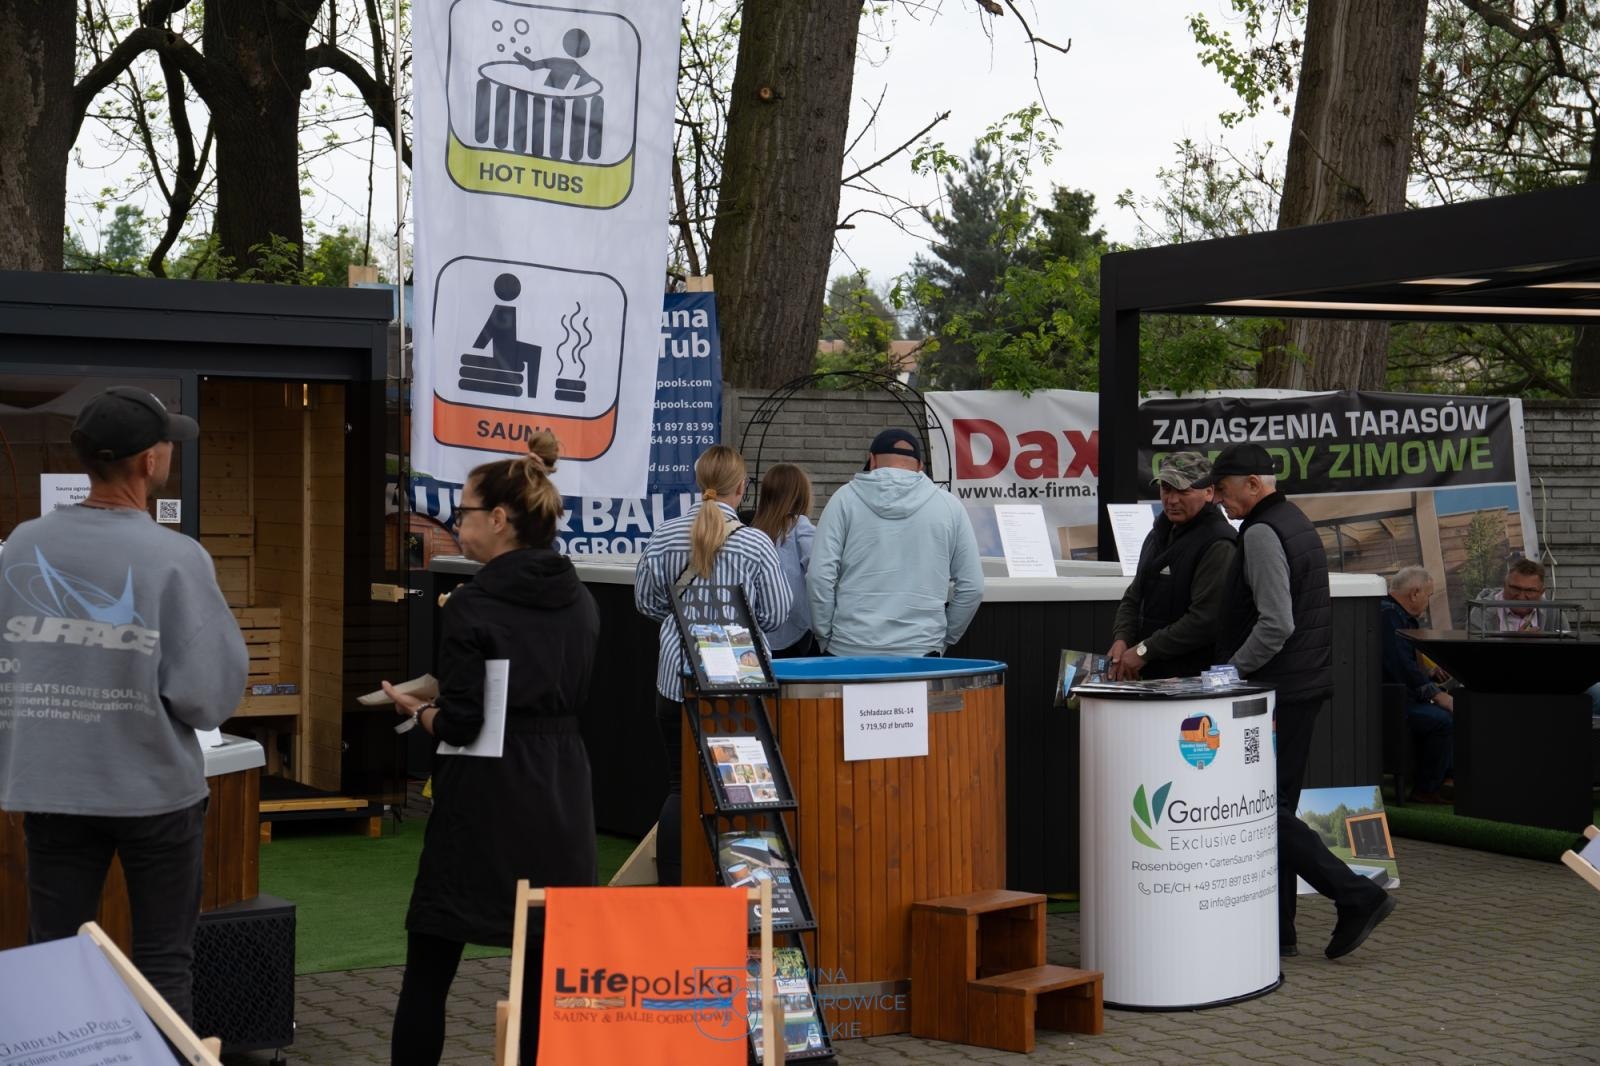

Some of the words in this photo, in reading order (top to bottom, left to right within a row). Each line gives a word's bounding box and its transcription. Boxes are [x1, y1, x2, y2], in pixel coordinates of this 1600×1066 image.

[479, 162, 526, 184] HOT
[531, 168, 584, 194] TUBS
[657, 377, 713, 391] pools.com
[653, 398, 713, 411] dpools.com
[476, 420, 553, 442] SAUN
[664, 422, 684, 431] 897
[686, 422, 699, 431] 83
[701, 422, 714, 431] 99
[1151, 412, 1338, 446] ZADASZENIA
[1345, 401, 1489, 437] TARASÓW
[665, 435, 678, 445] 49
[680, 435, 693, 445] 55
[695, 435, 714, 445] 763
[952, 418, 1098, 480] Dax
[1328, 436, 1494, 479] ZIMOWE
[658, 464, 670, 472] us
[958, 482, 1097, 499] www.dax-firma.
[3, 616, 160, 656] SURFACE
[895, 721, 914, 729] brutto
[1170, 834, 1237, 851] Exclusive
[1153, 881, 1191, 894] DE/CH
[1194, 880, 1210, 891] +49
[556, 968, 733, 1007] Lifepolska
[553, 1011, 598, 1023] SAUNY
[601, 1013, 611, 1023] &
[616, 1011, 654, 1023] BALIE
